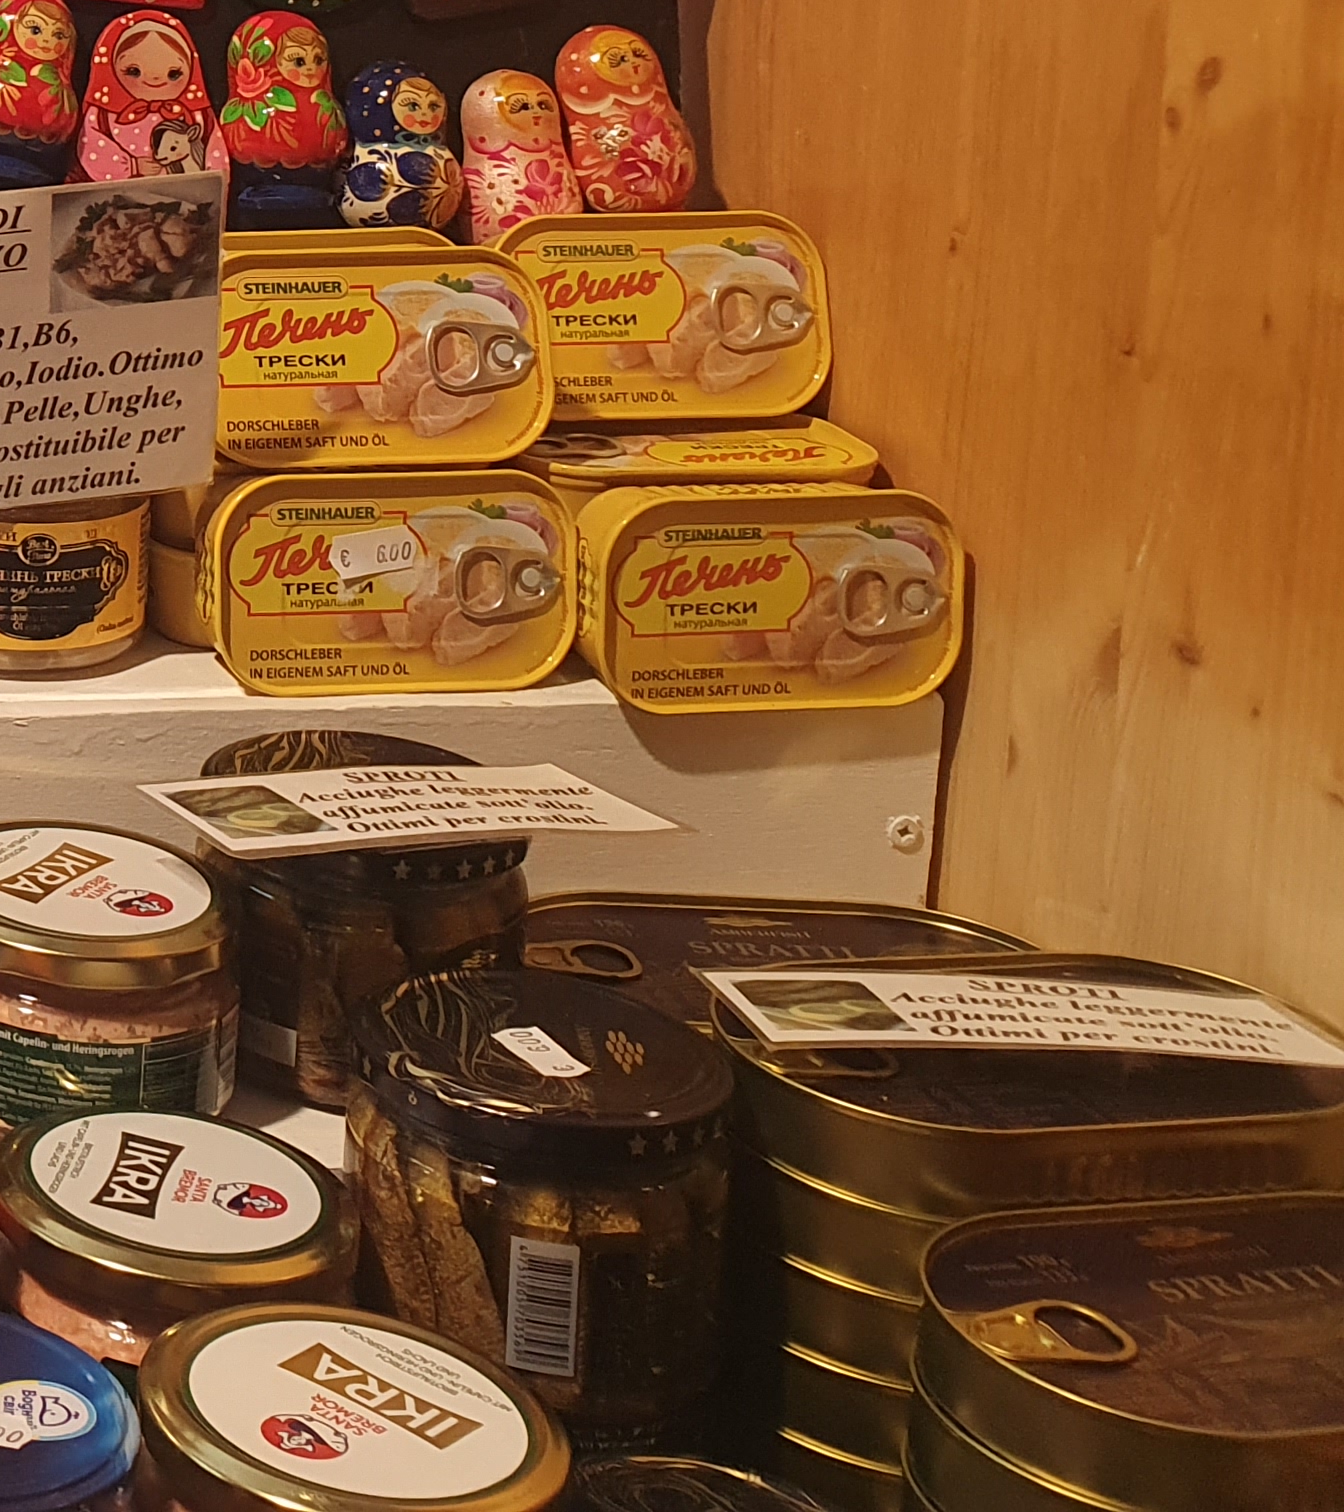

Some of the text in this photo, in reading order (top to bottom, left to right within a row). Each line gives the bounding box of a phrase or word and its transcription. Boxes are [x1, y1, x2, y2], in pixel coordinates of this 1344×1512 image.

[542, 244, 635, 258] STEINHAUER
[243, 281, 342, 295] STEINHAUER
[551, 314, 638, 328] ТРЕСКИ
[220, 307, 374, 359] Печень
[560, 329, 630, 340] натуральная
[253, 354, 346, 368] ТРЕСКИ
[263, 370, 338, 382] натуральная
[553, 376, 613, 387] SCHLEBER
[599, 389, 678, 404] SAFT UND ÖL
[227, 420, 320, 433] DORSCHLEBER
[137, 423, 185, 453] per
[228, 434, 390, 451] IN EIGENEM SAFT UND ÖL
[31, 462, 141, 495] anziani.
[277, 506, 375, 521] STEINHAUER
[663, 527, 762, 542] STEINHAUER
[339, 540, 411, 567] € 6.00
[623, 553, 791, 608] Печень
[665, 601, 758, 617] ТРЕСКИ
[672, 617, 748, 630] натуральная
[250, 648, 342, 662] DORSCHLEBER
[250, 661, 410, 679] IN EIGENEM SAFT UND ÖL
[631, 668, 725, 682] DORSCHLEBER
[631, 680, 791, 699] IN EIGENEM SAFT UND ÖL
[342, 771, 460, 783] SPROTI
[299, 784, 594, 804] Acciughe leggermente
[322, 799, 471, 820] affumicate
[346, 811, 608, 834] Ottimi per crostini.
[1, 848, 98, 895] IKRA
[967, 979, 1127, 1001] SPROTI
[891, 992, 1295, 1031] Acciughe leggermente
[910, 1009, 1107, 1028] affumicate
[929, 1024, 1045, 1040] Ottimi
[1060, 1030, 1120, 1043] per
[13, 1033, 50, 1049] Capelin-
[52, 1041, 70, 1052] und
[73, 1042, 134, 1057] Heringsrogen
[102, 1140, 170, 1205] IKRA
[313, 1352, 451, 1439] IKRA
[309, 1404, 368, 1436] SANTA
[311, 1393, 388, 1434] BREMOR
